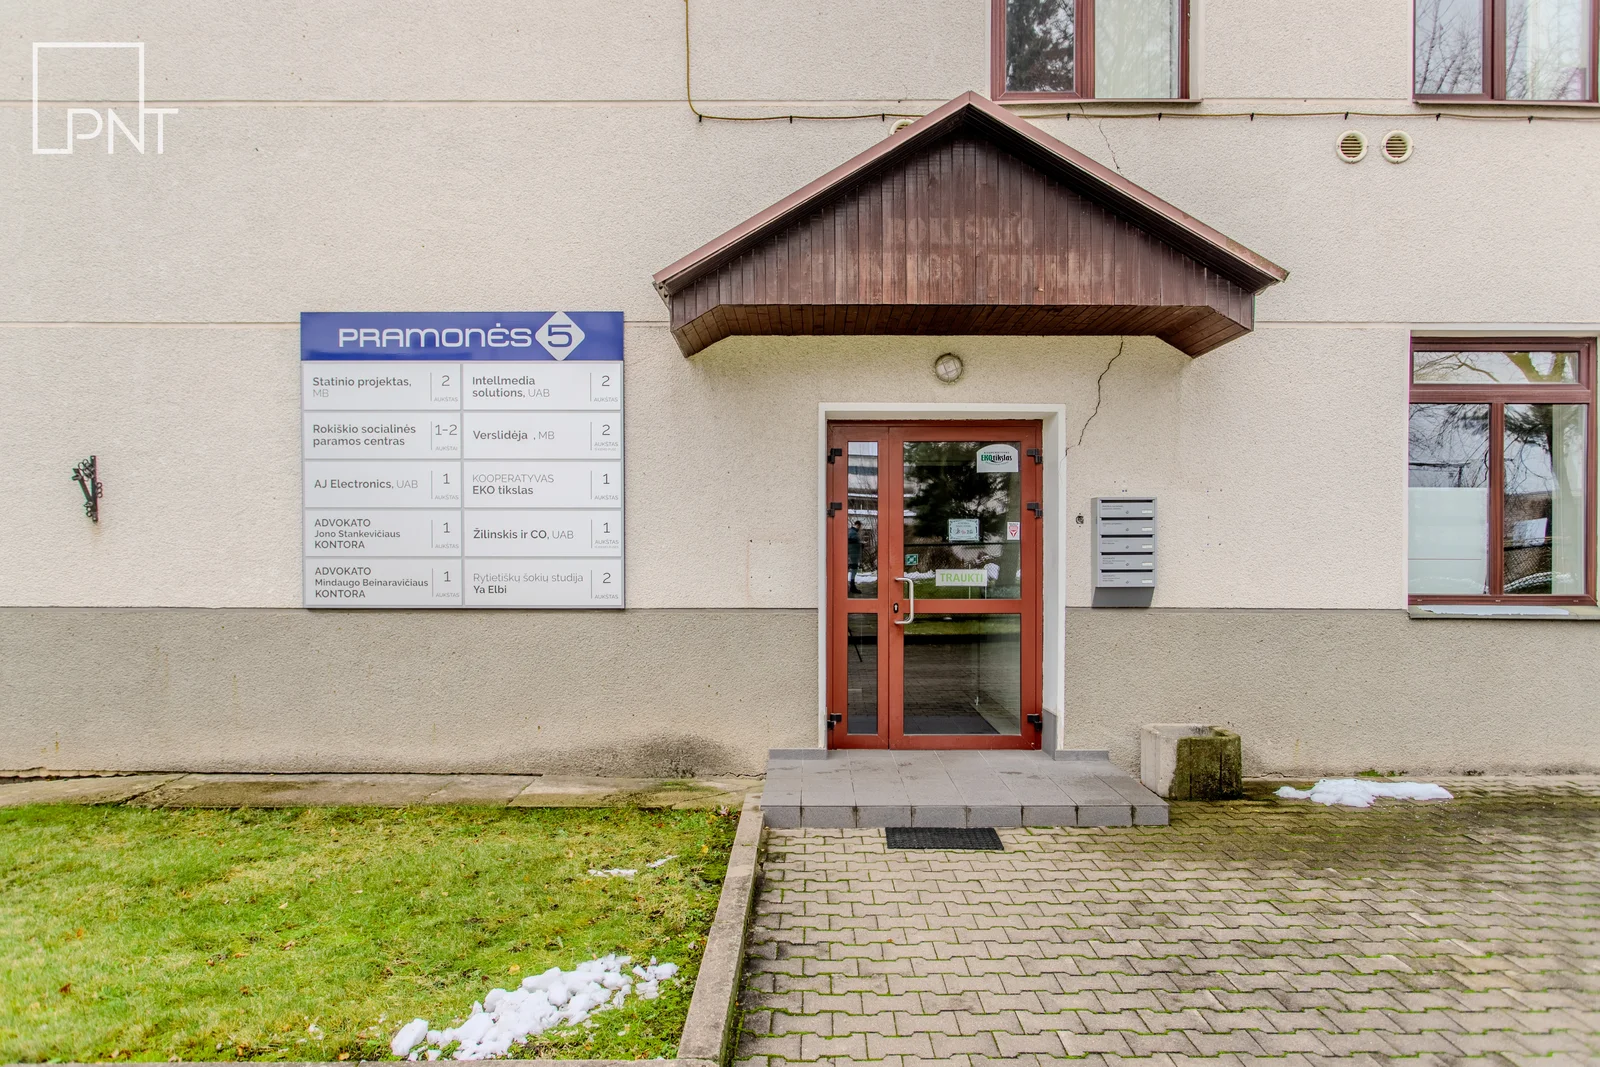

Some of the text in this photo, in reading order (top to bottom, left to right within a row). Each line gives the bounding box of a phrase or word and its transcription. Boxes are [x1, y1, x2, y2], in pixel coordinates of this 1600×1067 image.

[548, 325, 573, 348] 5
[313, 377, 412, 389] Statinio projektas,
[442, 375, 450, 386] 2
[473, 376, 536, 386] Intellmedia
[602, 375, 610, 386] 2
[313, 389, 329, 397] MB
[473, 388, 550, 399] solutions, UAB
[313, 424, 416, 433] Rokiškio socialinės
[435, 424, 457, 435] 1-2
[602, 424, 610, 435] 2
[473, 430, 528, 441] Verslidėja
[539, 431, 554, 440] MB
[313, 438, 405, 448] paramos centras
[443, 473, 450, 484] 1
[473, 474, 554, 483] KOOPERATYVAS
[603, 474, 610, 484] 1
[314, 479, 418, 490] AJ Electronics, UAB
[473, 485, 533, 494] EKO tikslas
[315, 519, 371, 527] ADVOKATO
[443, 522, 450, 533] 1
[604, 522, 610, 533] 1
[314, 530, 336, 538] Jono
[473, 527, 574, 540] Žilinskis ir CO, UAB
[315, 567, 371, 575] ADVOKATO
[444, 571, 451, 582] 1
[473, 573, 583, 584] Rytietiškų šokių studija
[603, 573, 611, 583] 2
[940, 573, 983, 583] TRAUKTI
[315, 579, 360, 588] Mindaugo
[316, 590, 365, 598] KONTORA
[488, 585, 506, 593] Elbi
